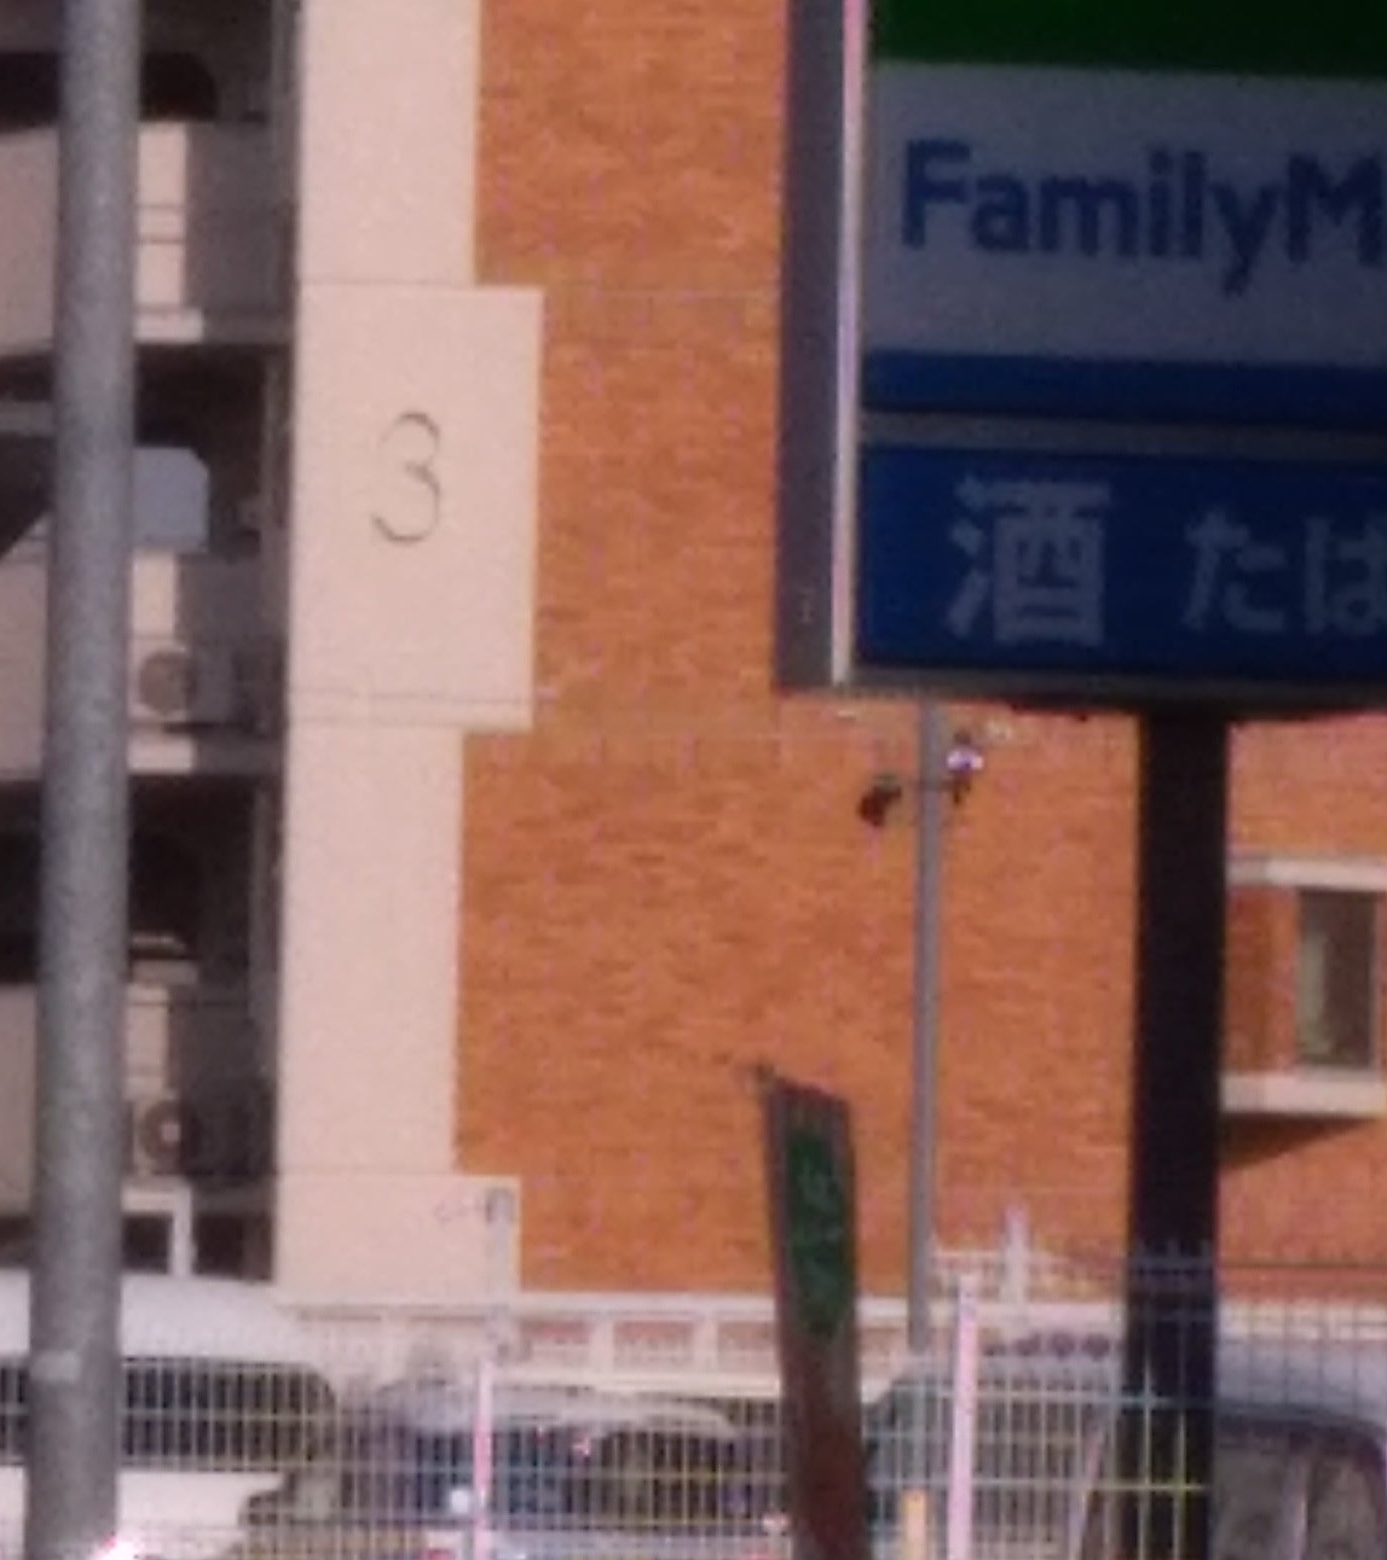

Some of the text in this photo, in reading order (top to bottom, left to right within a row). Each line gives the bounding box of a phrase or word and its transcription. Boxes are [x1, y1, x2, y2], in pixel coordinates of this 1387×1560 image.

[901, 137, 1387, 296] FamilyM
[372, 411, 441, 544] 3
[945, 474, 1112, 647] 酒
